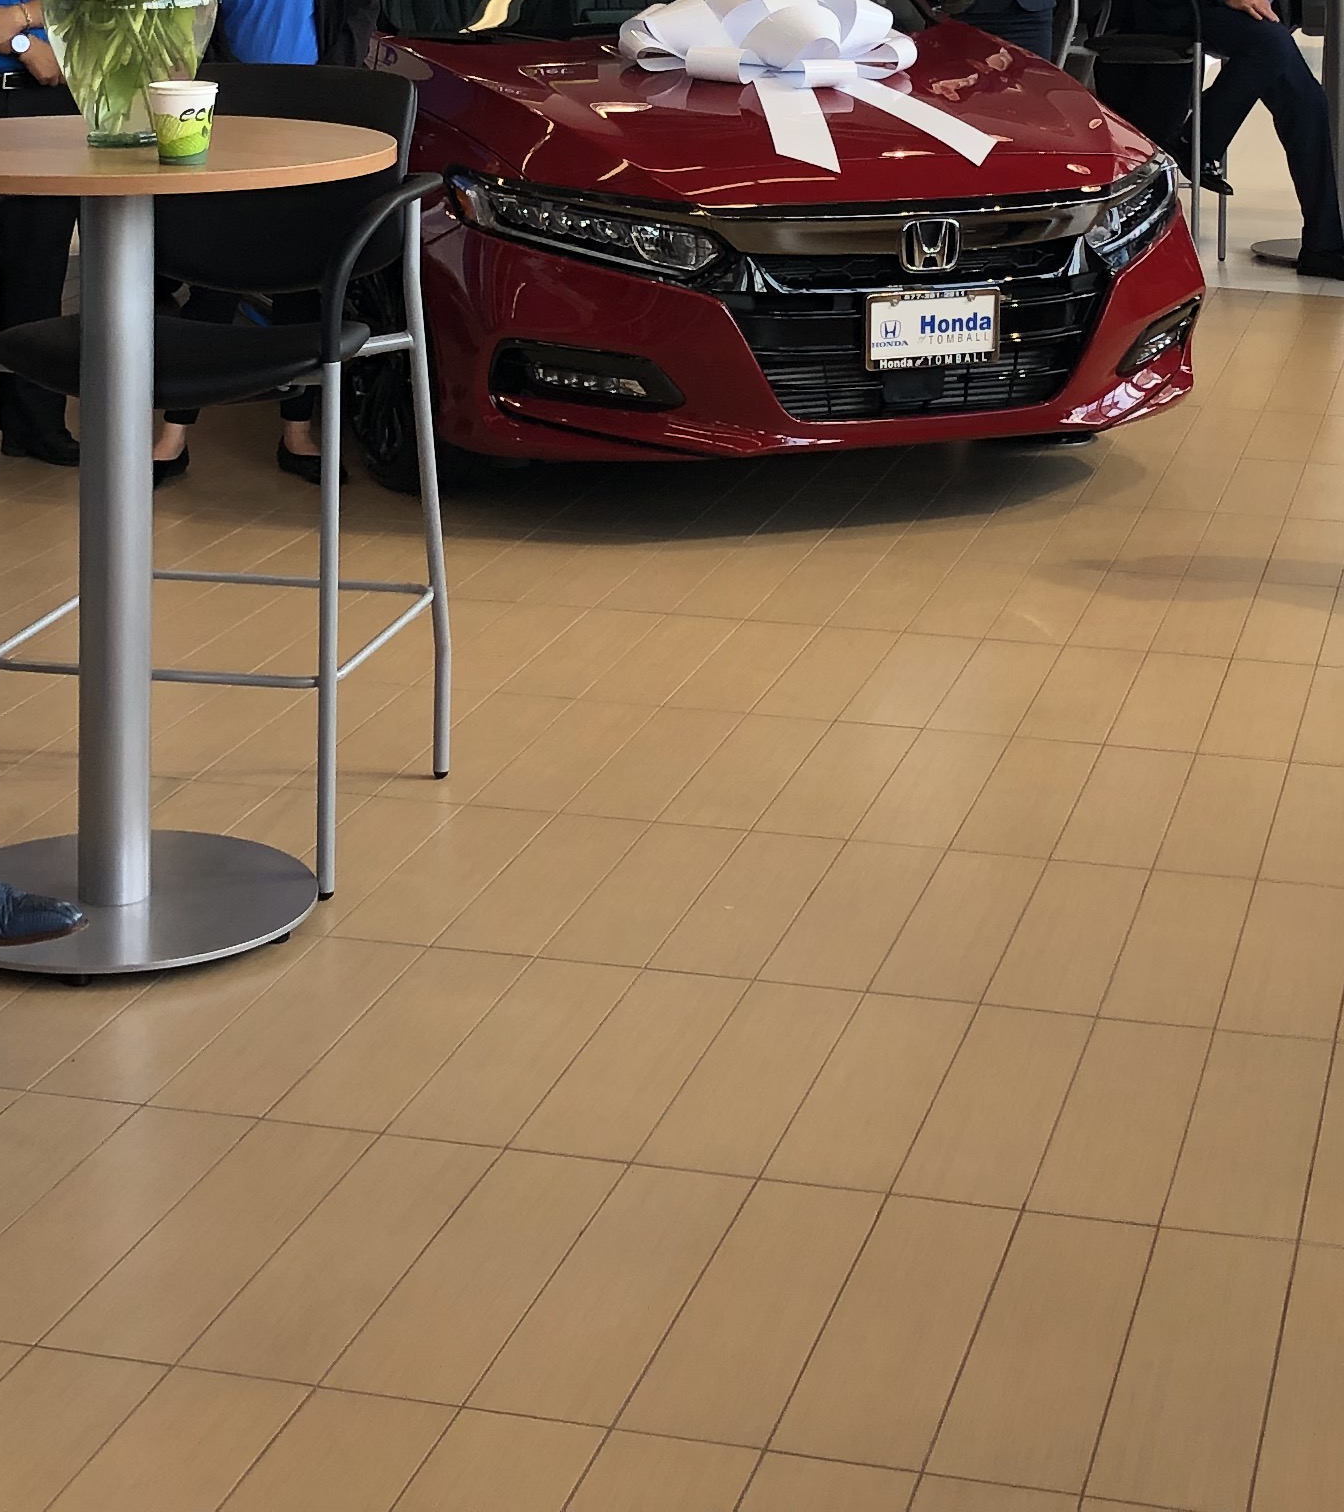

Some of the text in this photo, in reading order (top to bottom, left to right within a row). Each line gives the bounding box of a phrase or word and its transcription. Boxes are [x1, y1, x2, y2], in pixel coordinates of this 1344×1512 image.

[920, 312, 992, 335] Honda
[871, 340, 909, 348] HONDA
[928, 332, 990, 345] TOMBALL
[879, 357, 913, 370] Honda
[926, 351, 988, 366] TOMBALL
